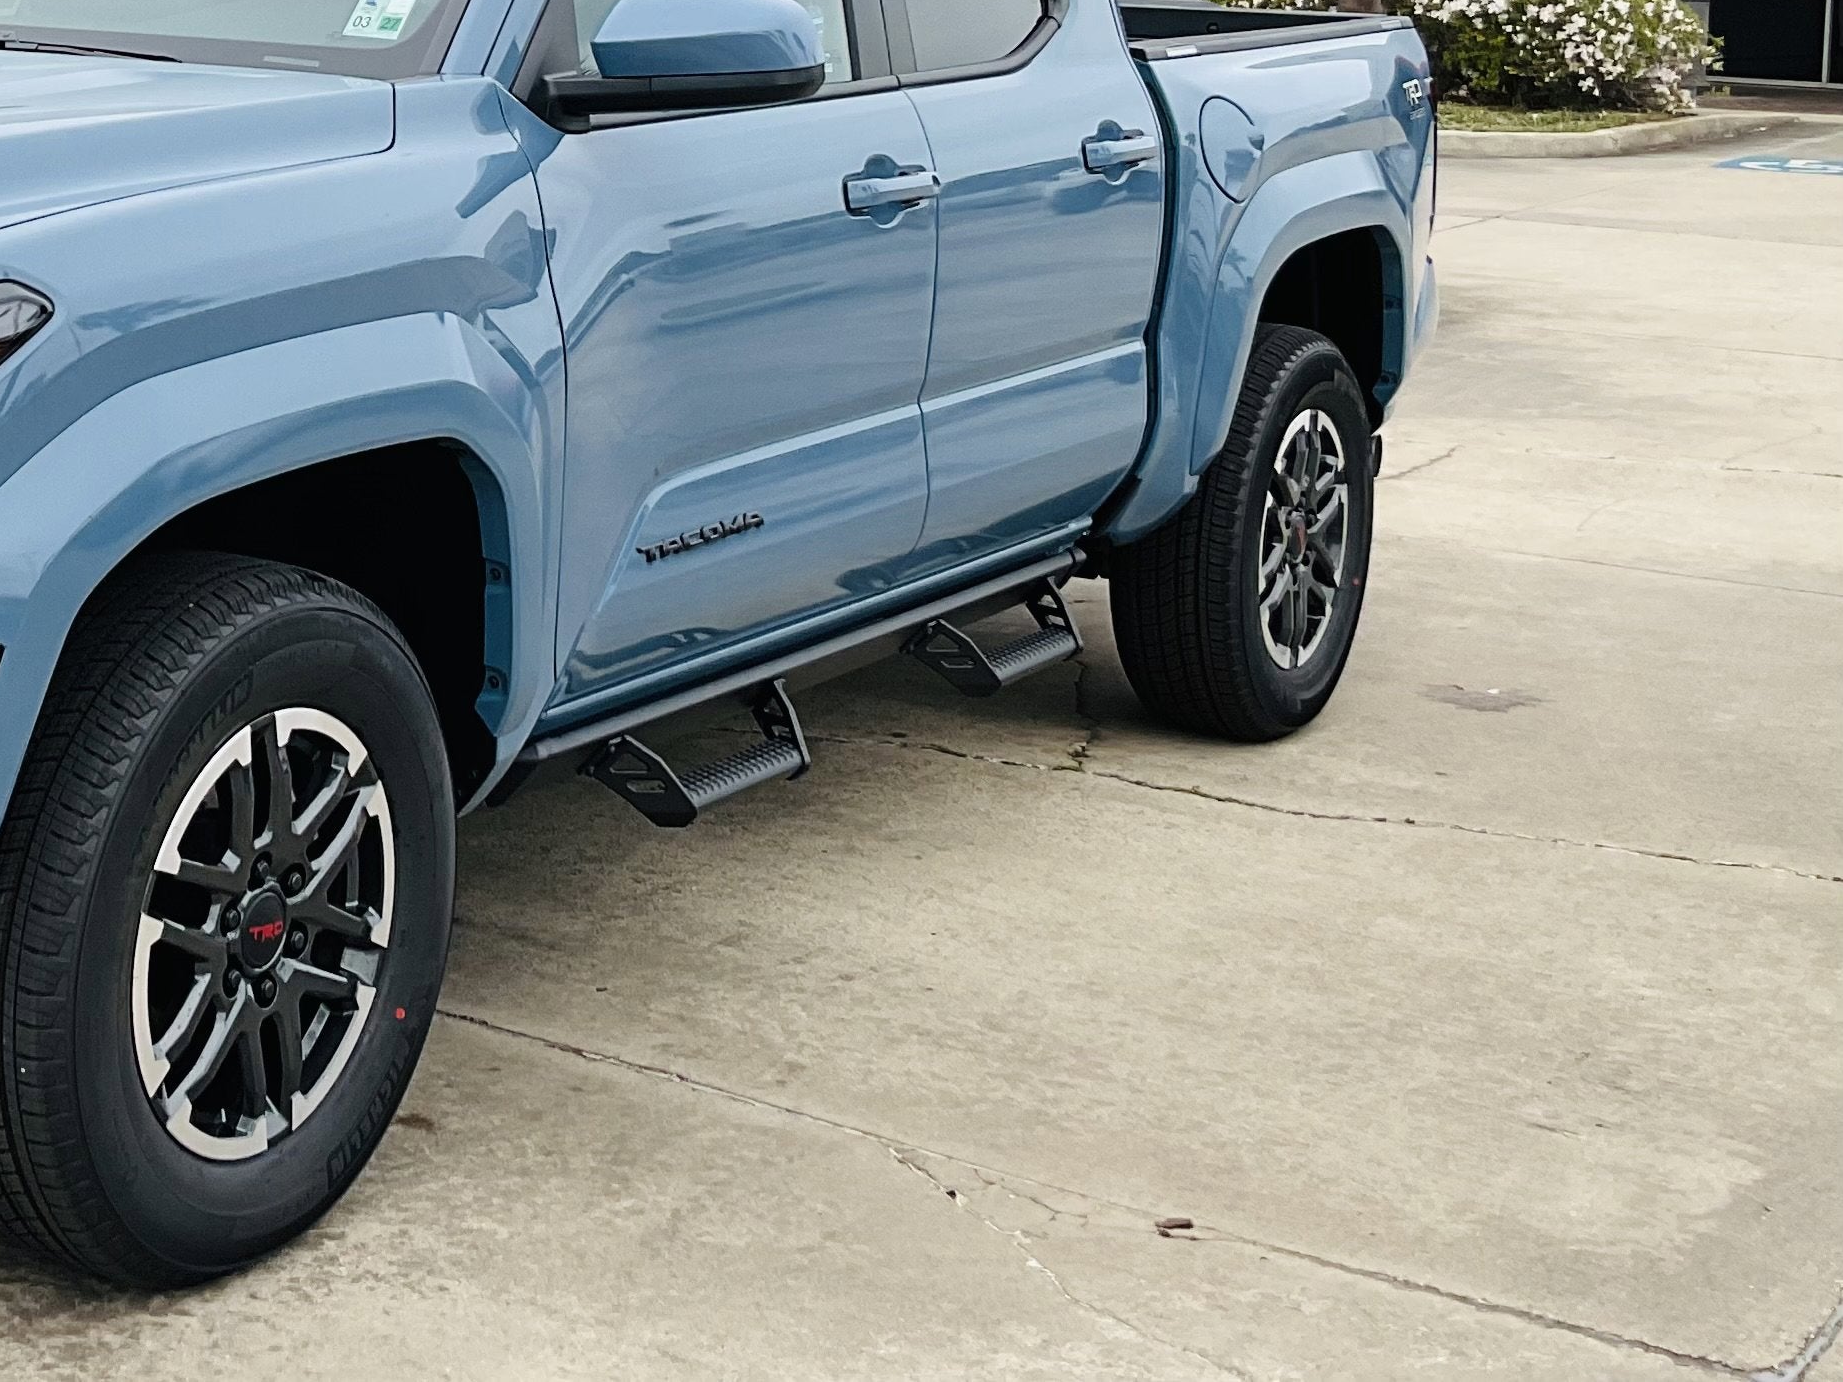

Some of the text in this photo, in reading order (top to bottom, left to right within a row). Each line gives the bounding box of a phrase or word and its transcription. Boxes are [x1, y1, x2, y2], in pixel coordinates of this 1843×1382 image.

[352, 15, 402, 30] 03 27
[635, 510, 764, 563] TACOMA
[249, 921, 283, 942] TRD
